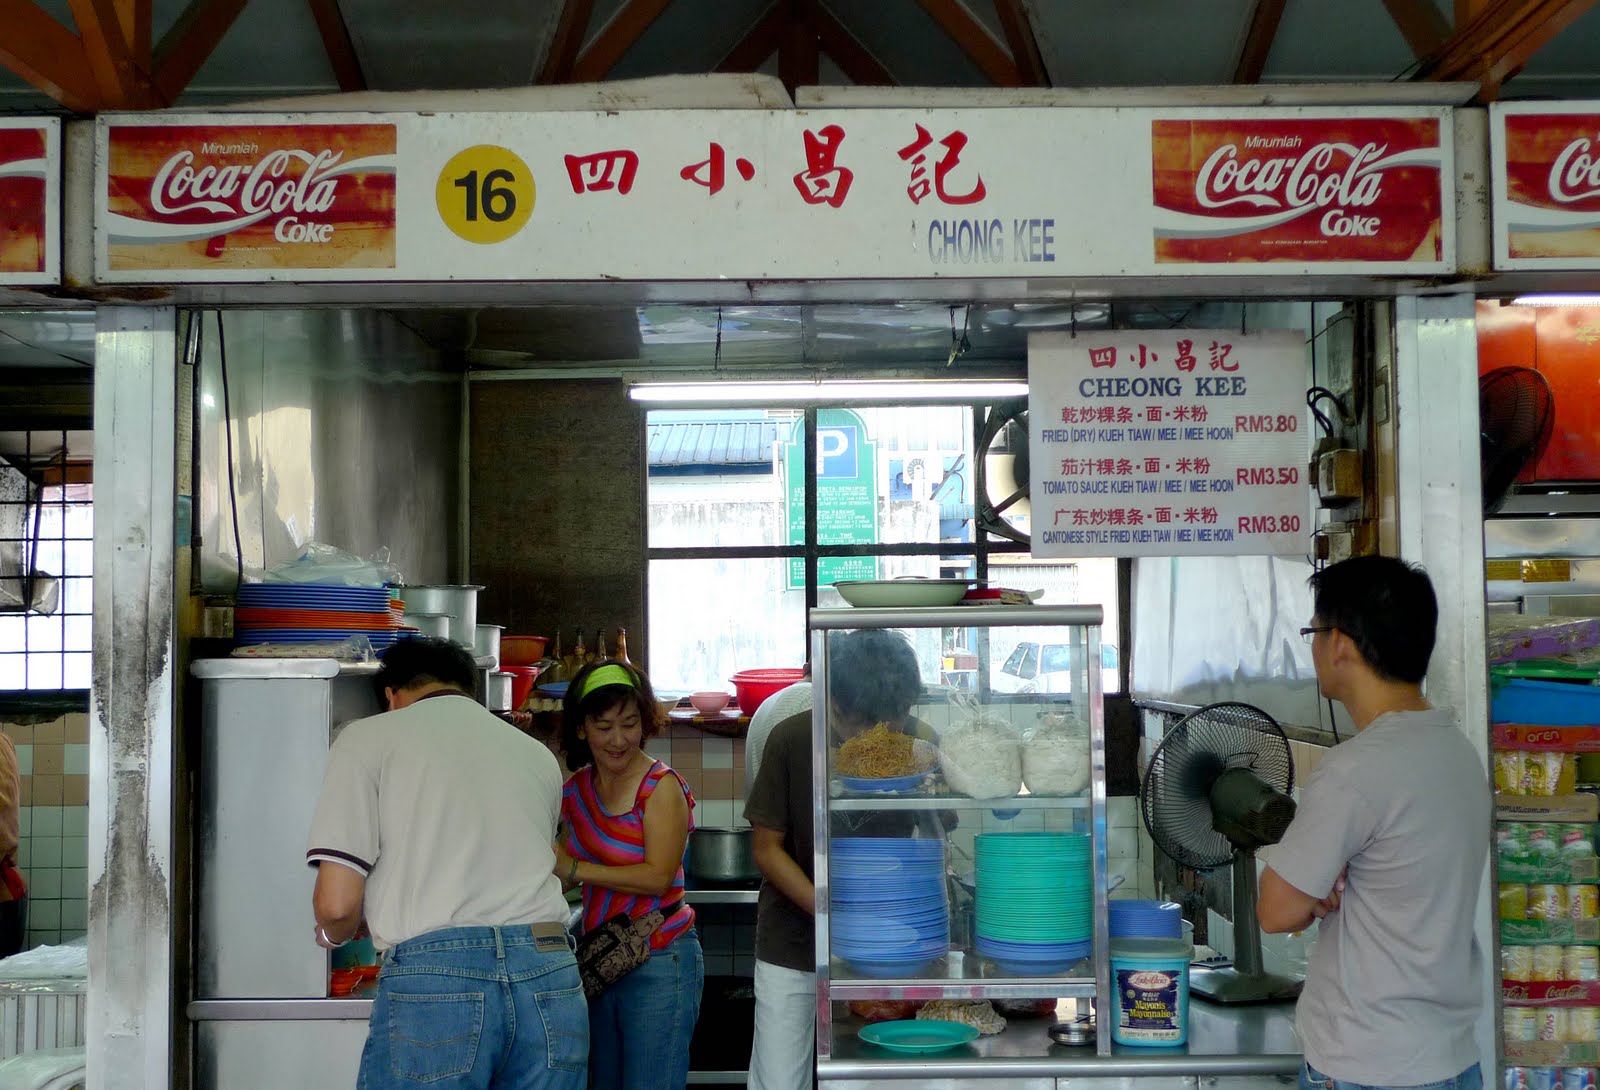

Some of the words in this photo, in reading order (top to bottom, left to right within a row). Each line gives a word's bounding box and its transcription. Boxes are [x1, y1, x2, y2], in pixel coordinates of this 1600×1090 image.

[201, 142, 258, 155] Minumlah
[1245, 136, 1302, 148] Minumlah
[564, 123, 986, 208] 四小昌記
[1195, 142, 1389, 208] Coca-Cola
[151, 149, 343, 215] Coca-Cola
[454, 169, 517, 222] 16
[275, 216, 335, 244] Coke
[1320, 209, 1381, 237] Coke
[928, 218, 1004, 264] CHONG
[1014, 218, 1055, 262] KEE
[1088, 339, 1240, 373] 四小昌記
[1079, 377, 1182, 398] CHEONG
[1195, 376, 1247, 396] KEE
[1042, 430, 1069, 443] FRIED
[1070, 428, 1096, 443] (DRY)
[1098, 429, 1124, 442] KUEH
[1128, 428, 1151, 441] TIAW
[1157, 428, 1177, 441] MEE
[1185, 427, 1204, 440] MEE
[1206, 427, 1234, 440] HOON
[1235, 415, 1298, 433] RM3.80
[817, 430, 848, 474] P
[1042, 481, 1079, 495] TOMATO
[1080, 480, 1108, 493] SAUCE
[1111, 480, 1134, 493] KUEH
[1136, 480, 1158, 493] TIAW
[1165, 480, 1182, 492] MEE
[1190, 479, 1207, 492] MEE
[1210, 479, 1234, 492] HOON
[1236, 467, 1299, 485] RM3.50
[1238, 515, 1300, 534] RM3.80
[1042, 531, 1084, 544] CANTONESE
[1086, 530, 1108, 543] STYLE
[1110, 530, 1130, 543] FRIED
[1132, 530, 1151, 543] KUEH
[1153, 530, 1171, 542] TIAW
[1177, 529, 1191, 542] MEE
[1197, 529, 1212, 542] MEE
[1213, 529, 1234, 542] HOON
[1129, 1009, 1171, 1018] Mayonnaise
